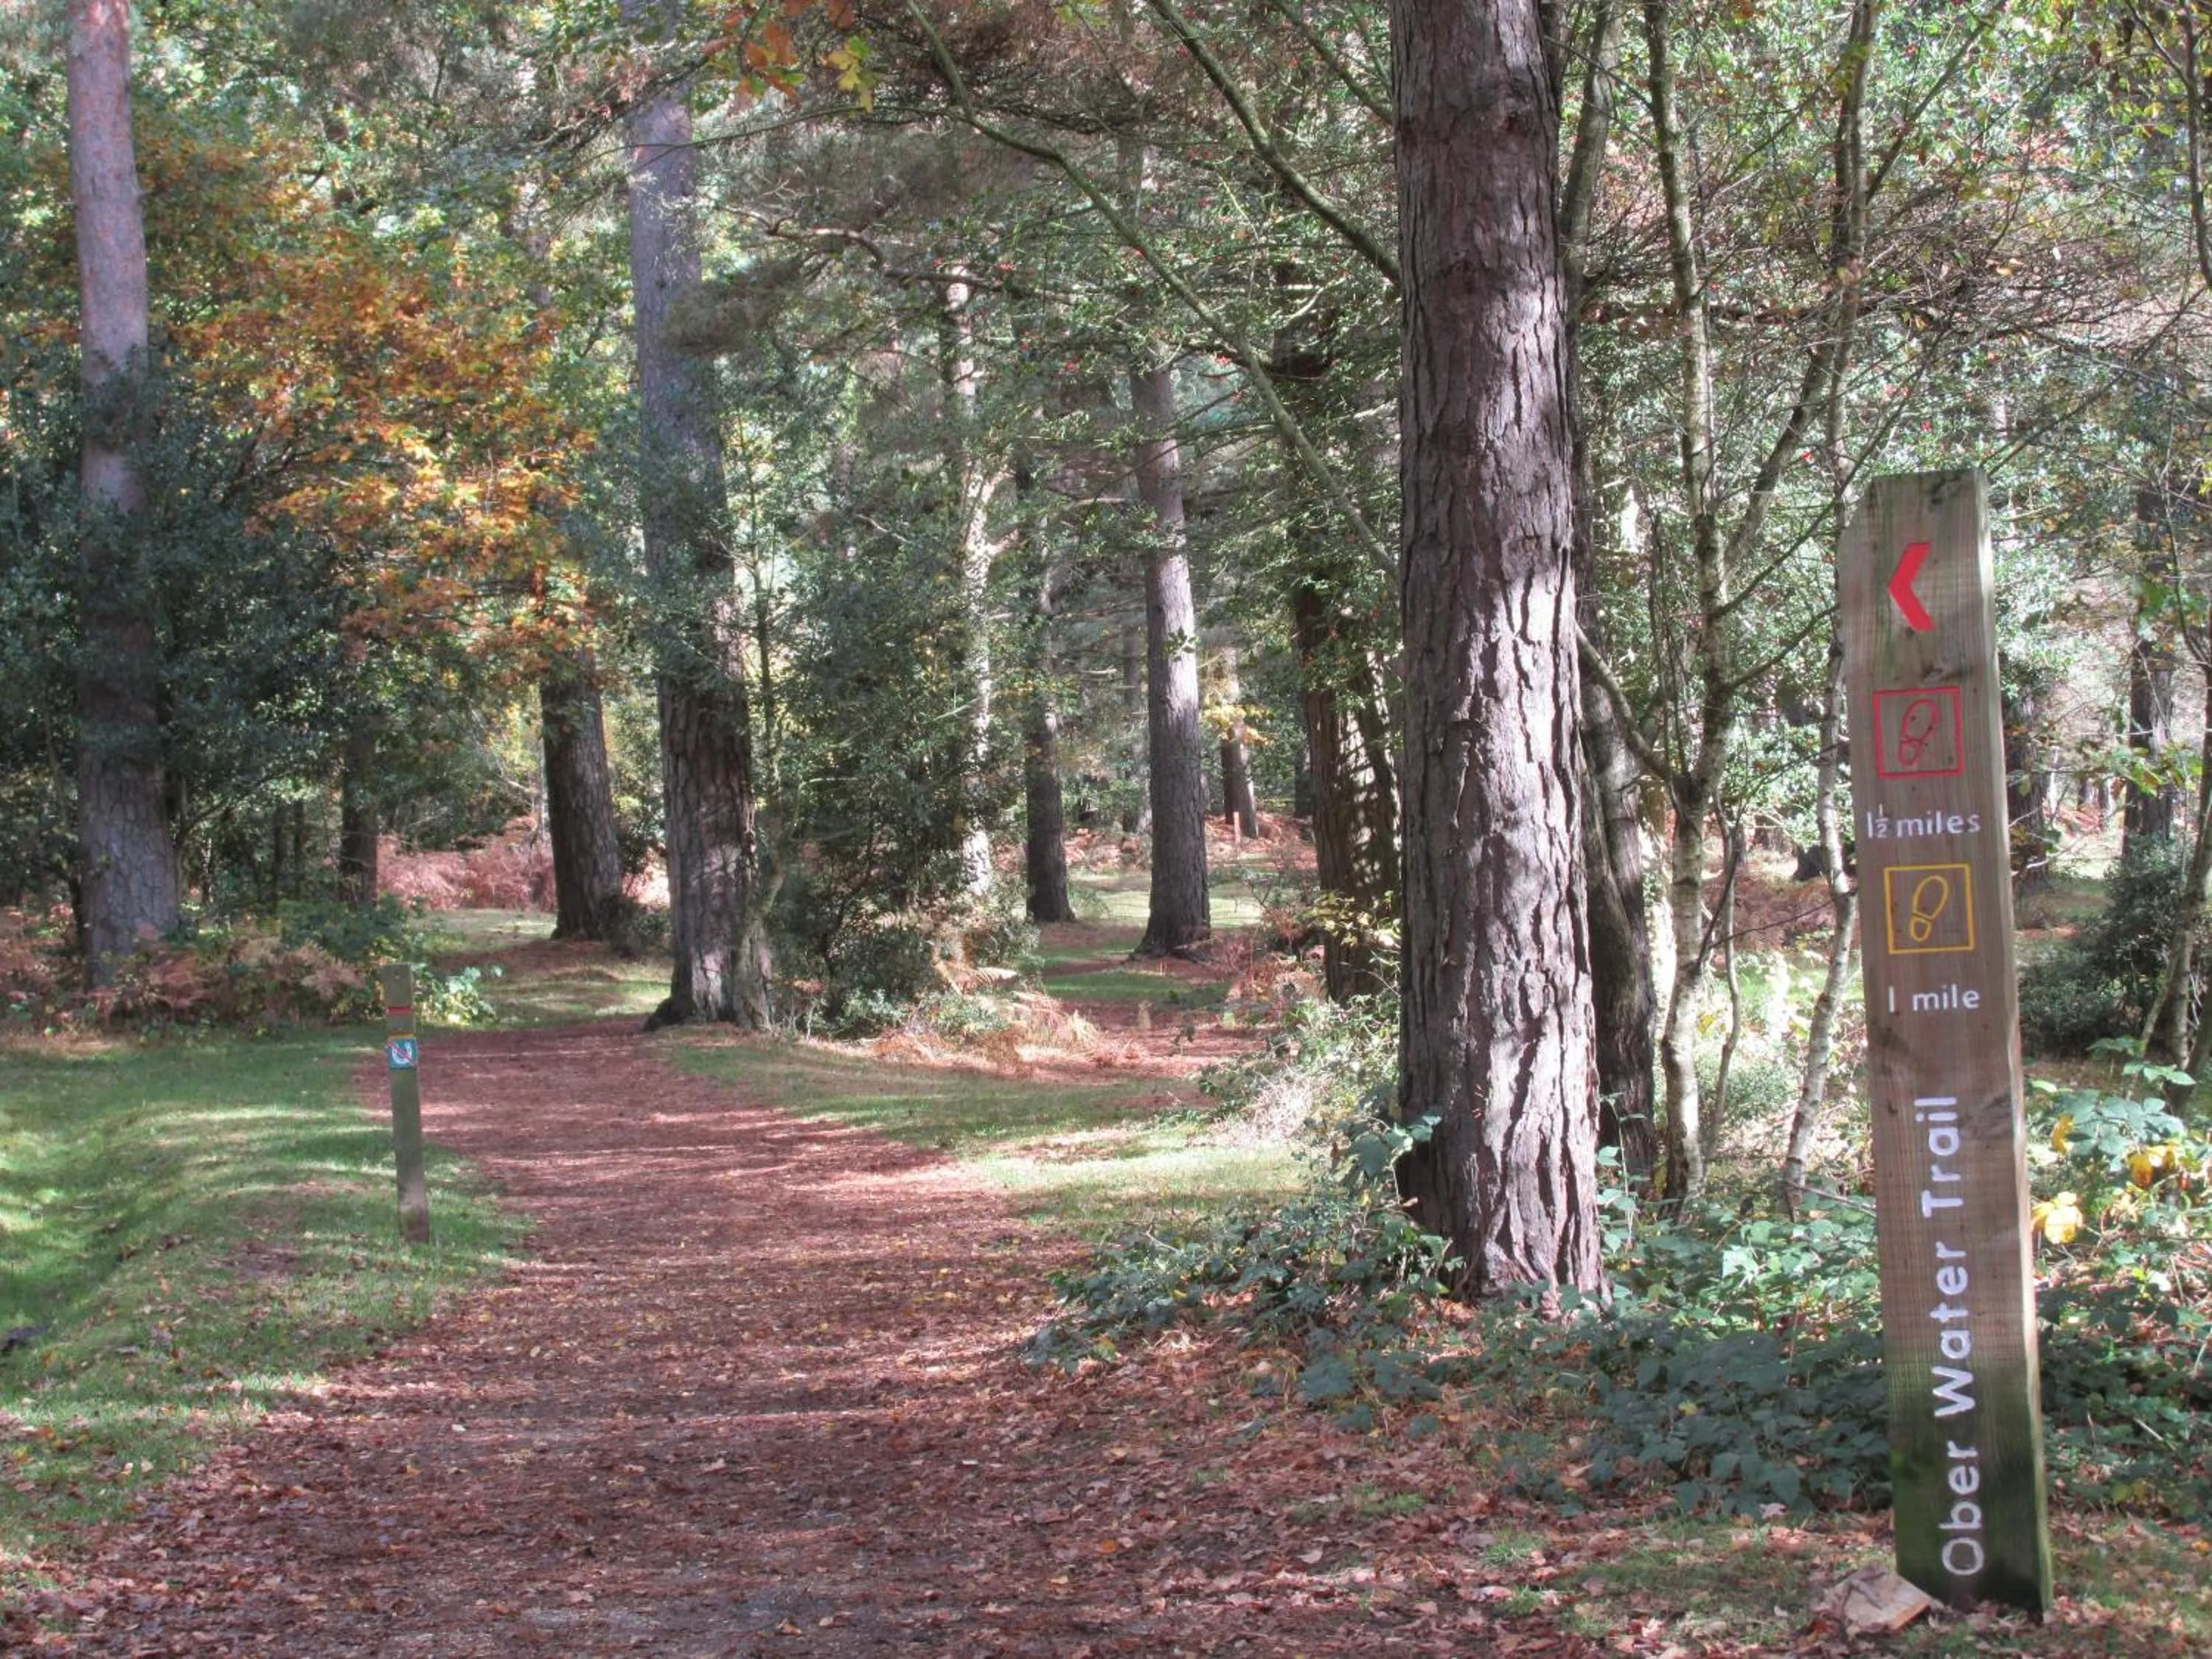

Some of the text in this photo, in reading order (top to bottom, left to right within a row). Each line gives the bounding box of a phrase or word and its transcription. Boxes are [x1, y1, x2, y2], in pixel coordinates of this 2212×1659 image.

[1897, 810, 1981, 838] miles
[1912, 984, 1980, 1011] mile
[1914, 1096, 1986, 1576] Ober Water Trail
